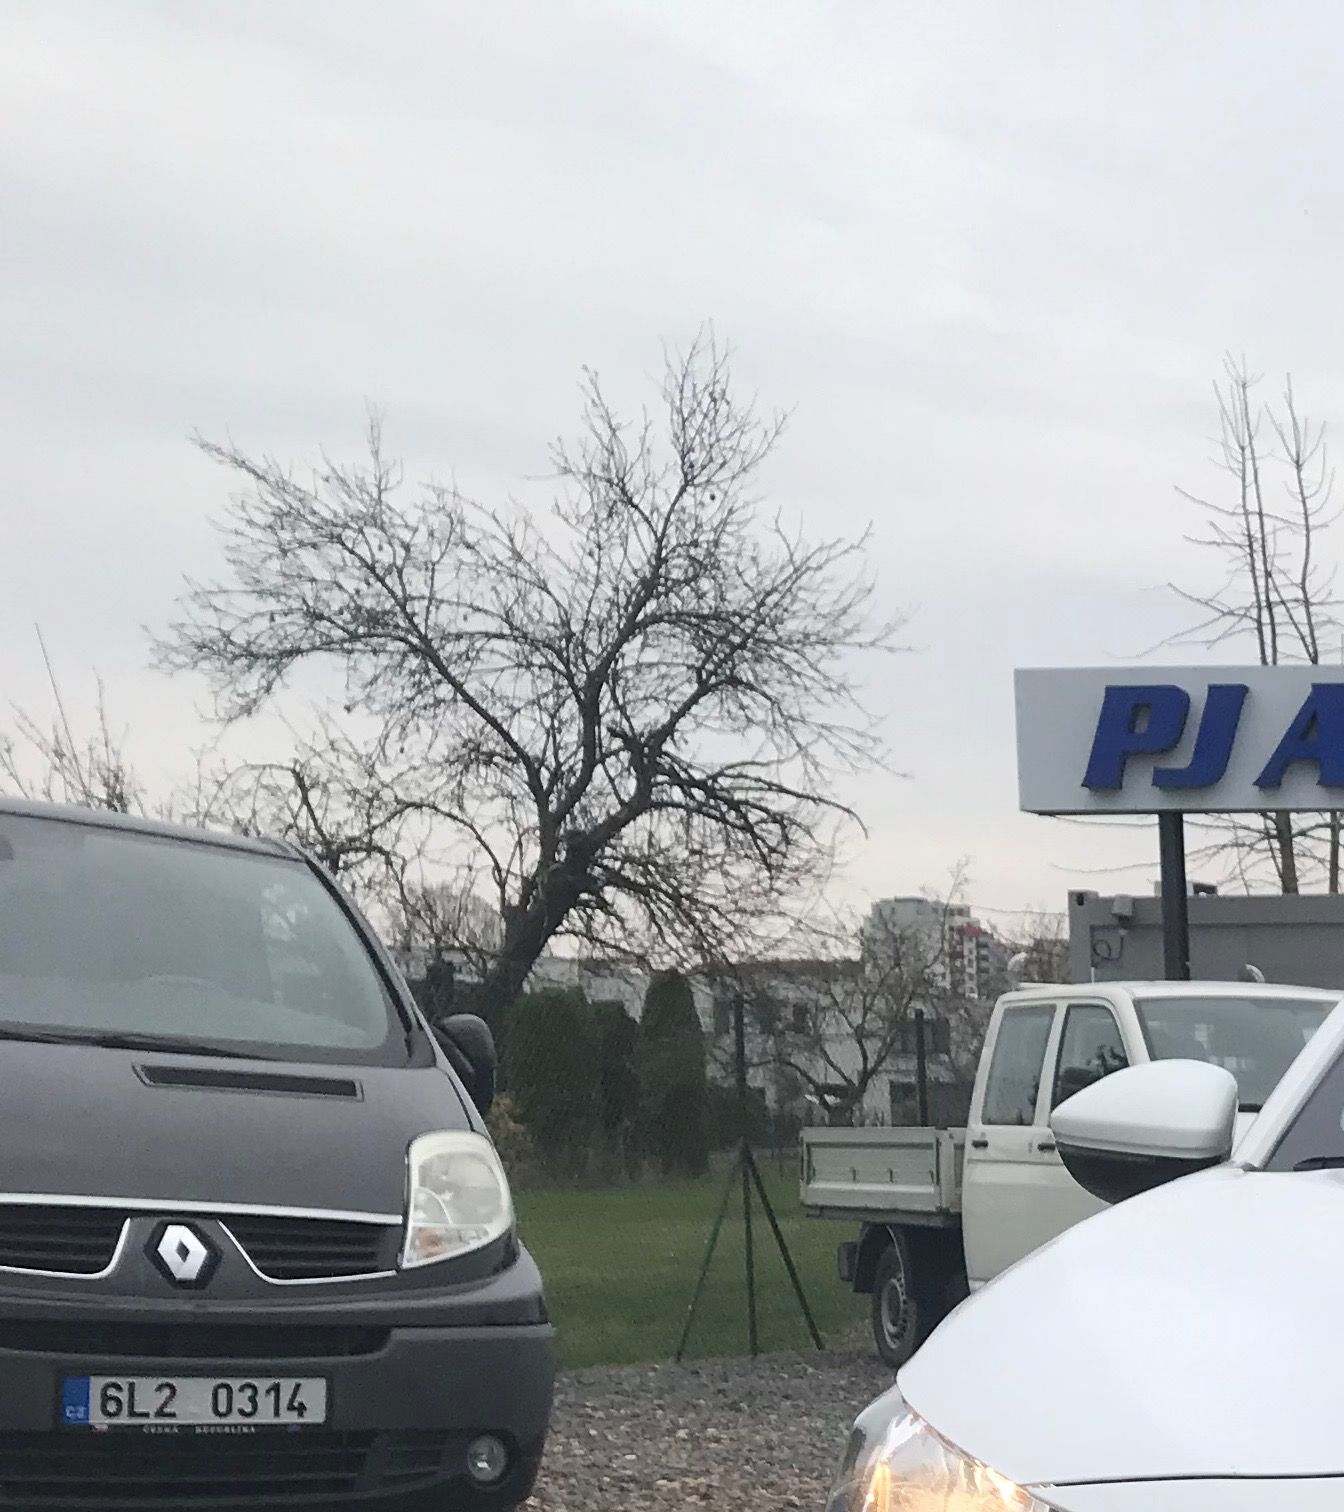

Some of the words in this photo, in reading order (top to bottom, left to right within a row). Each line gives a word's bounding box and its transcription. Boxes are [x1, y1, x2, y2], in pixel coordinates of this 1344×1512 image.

[1081, 683, 1250, 791] PJ
[100, 1381, 177, 1418] 6L2
[211, 1382, 307, 1418] 0314
